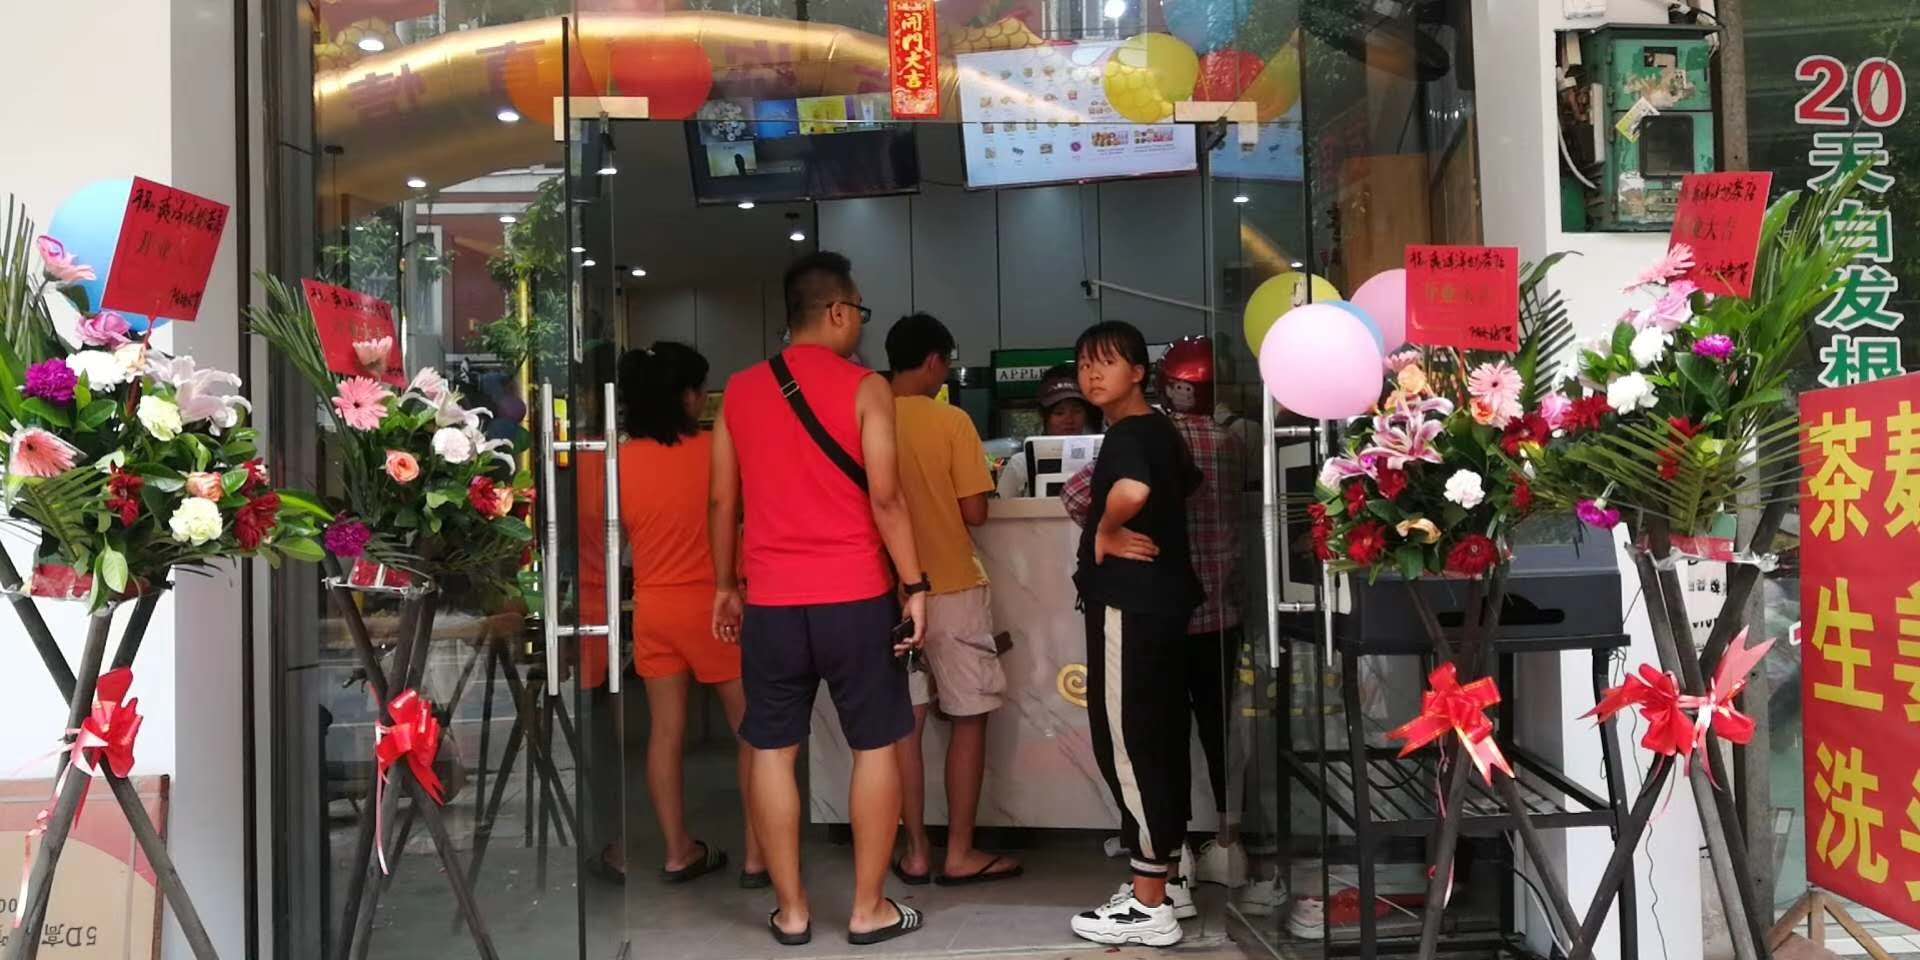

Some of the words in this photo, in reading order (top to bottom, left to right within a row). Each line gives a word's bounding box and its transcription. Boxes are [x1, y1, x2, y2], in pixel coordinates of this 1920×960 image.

[1796, 55, 1906, 127] 20
[1814, 742, 1920, 902] 洗
[41, 923, 97, 947] 5D高
